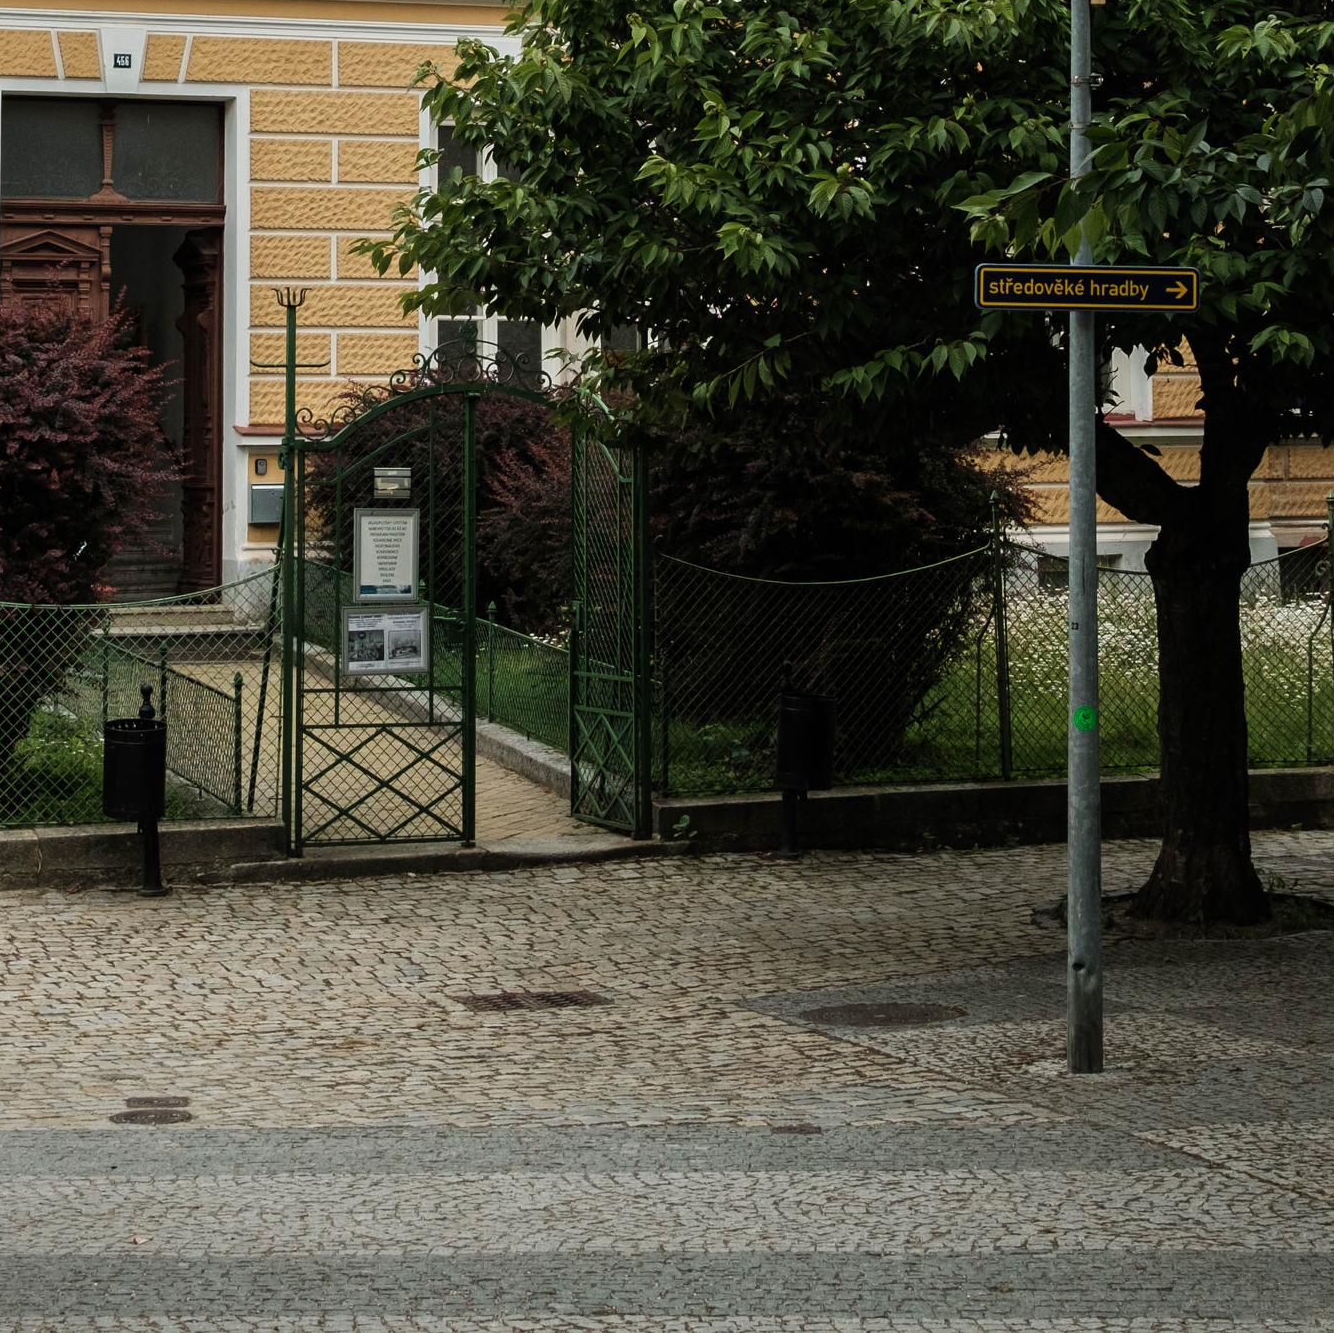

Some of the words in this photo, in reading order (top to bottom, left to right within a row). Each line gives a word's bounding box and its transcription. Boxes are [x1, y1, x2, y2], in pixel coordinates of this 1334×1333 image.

[116, 55, 130, 66] 456
[989, 278, 1085, 296] středověké
[1090, 279, 1149, 301] hradby
